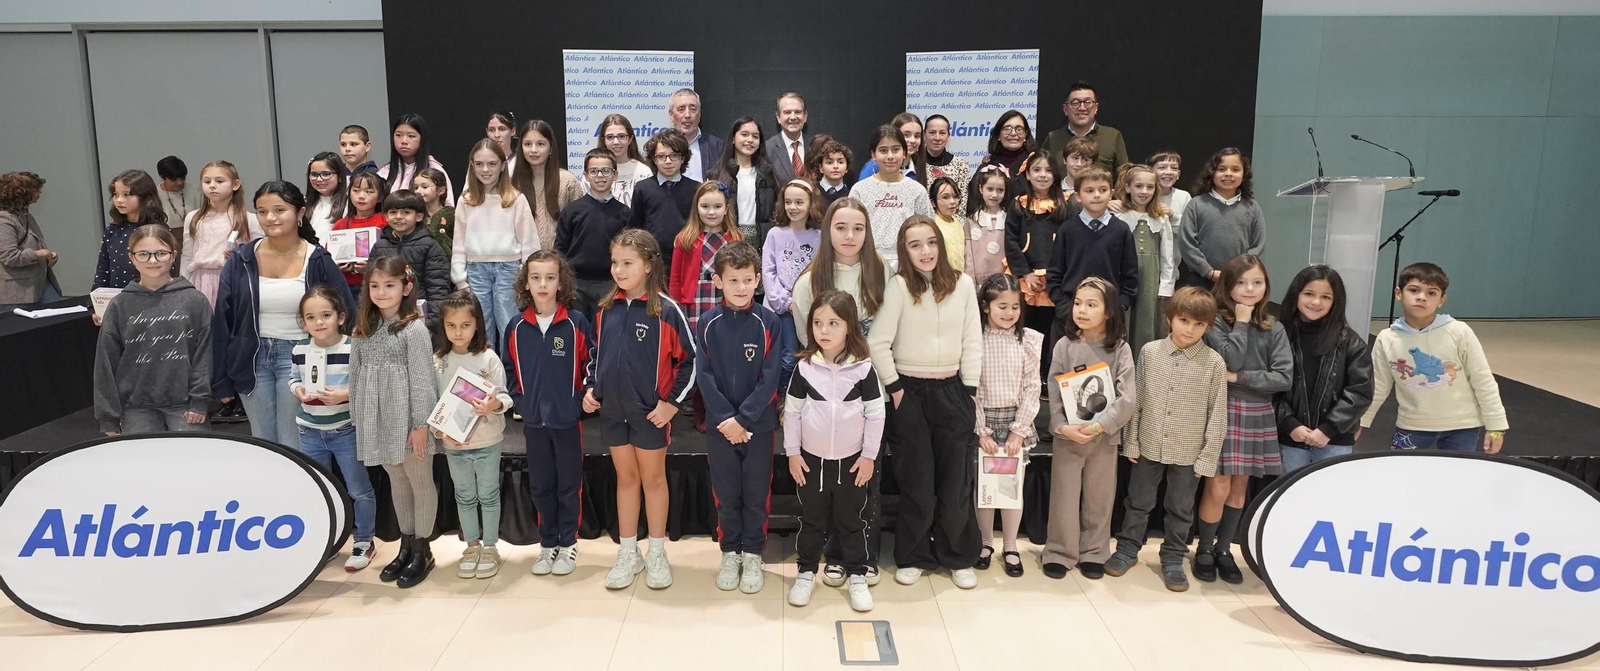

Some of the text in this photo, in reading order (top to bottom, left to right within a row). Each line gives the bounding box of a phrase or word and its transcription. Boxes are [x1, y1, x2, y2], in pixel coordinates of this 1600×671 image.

[431, 402, 446, 423] Lenovo
[435, 415, 445, 425] Tab
[18, 500, 305, 558] Atlántico
[1289, 520, 1600, 593] Atlántico
